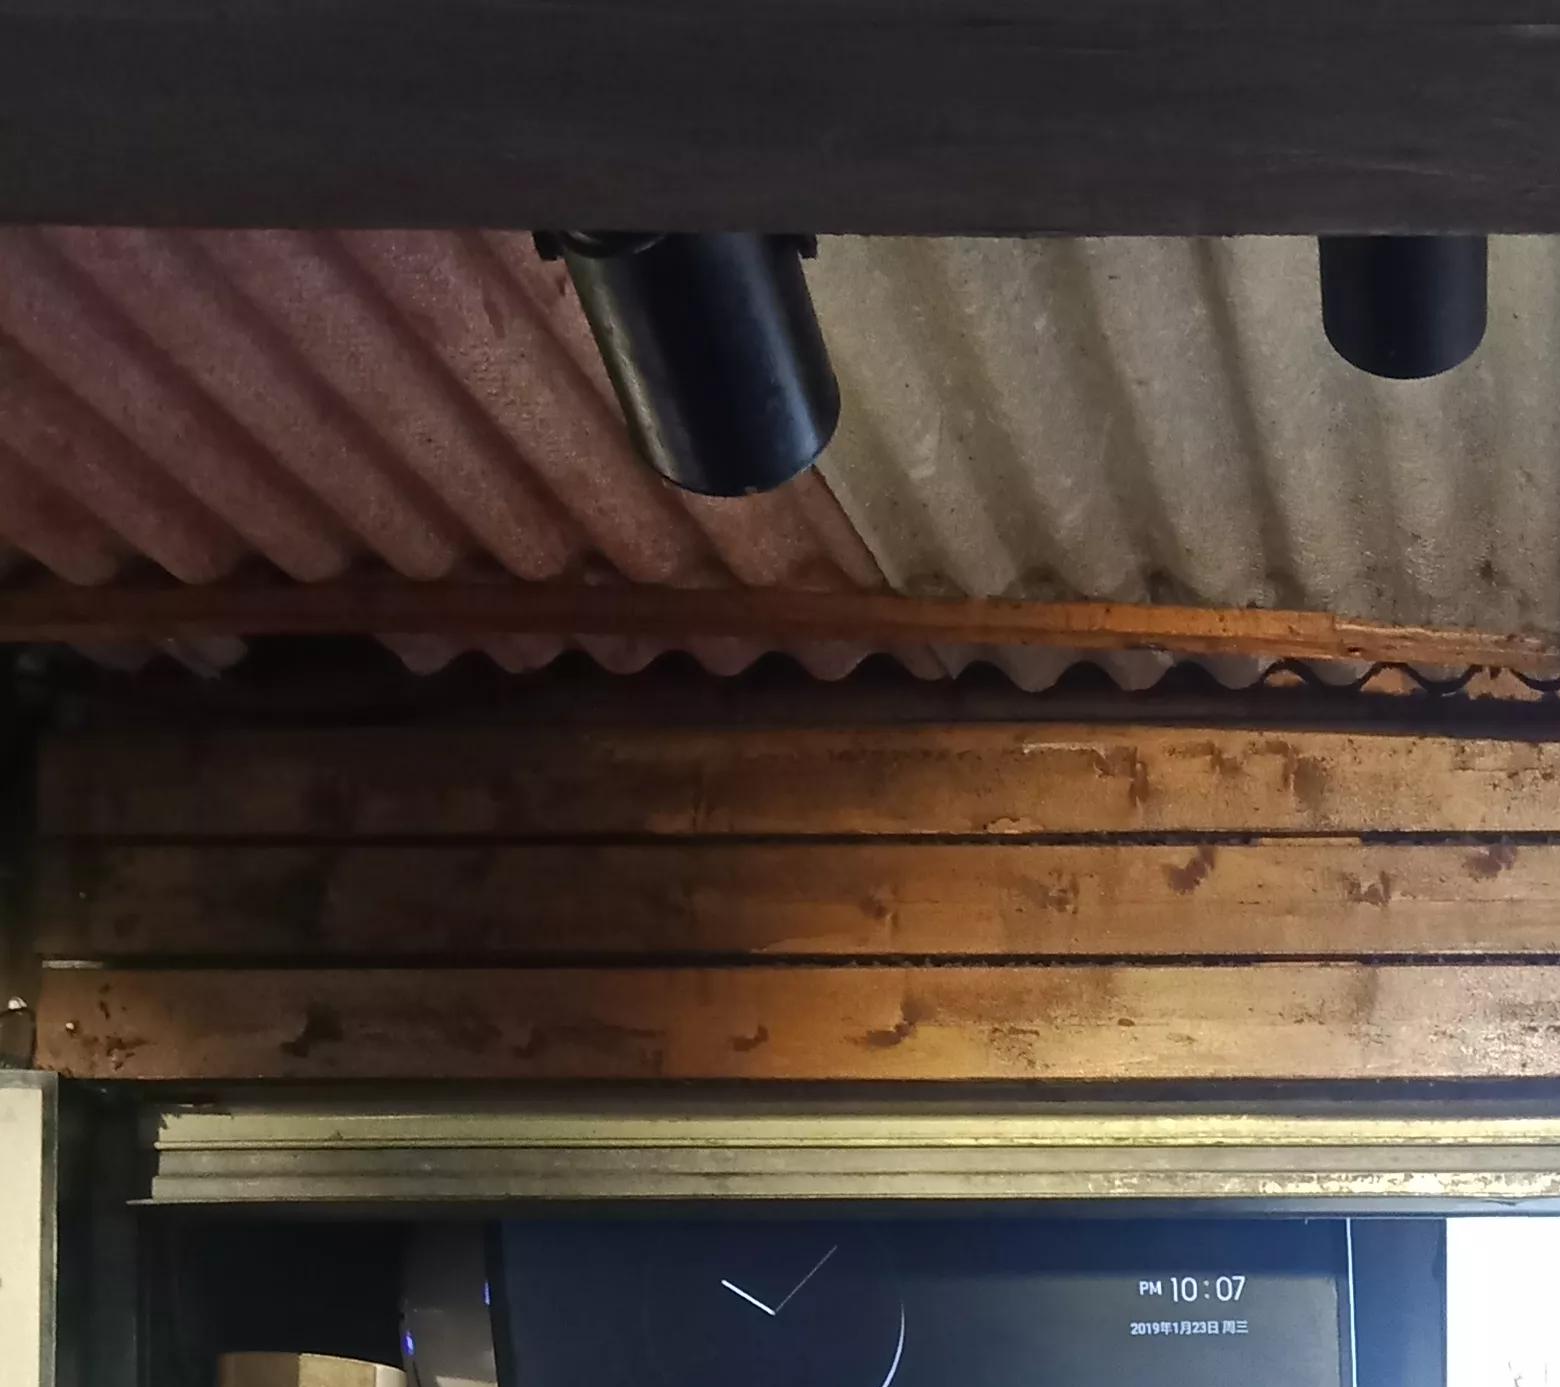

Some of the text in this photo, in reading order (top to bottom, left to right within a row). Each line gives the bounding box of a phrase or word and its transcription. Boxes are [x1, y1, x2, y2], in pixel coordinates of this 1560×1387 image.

[1139, 1275, 1246, 1302] PM 10:07
[1129, 1320, 1219, 1335] 2019年1月23日
